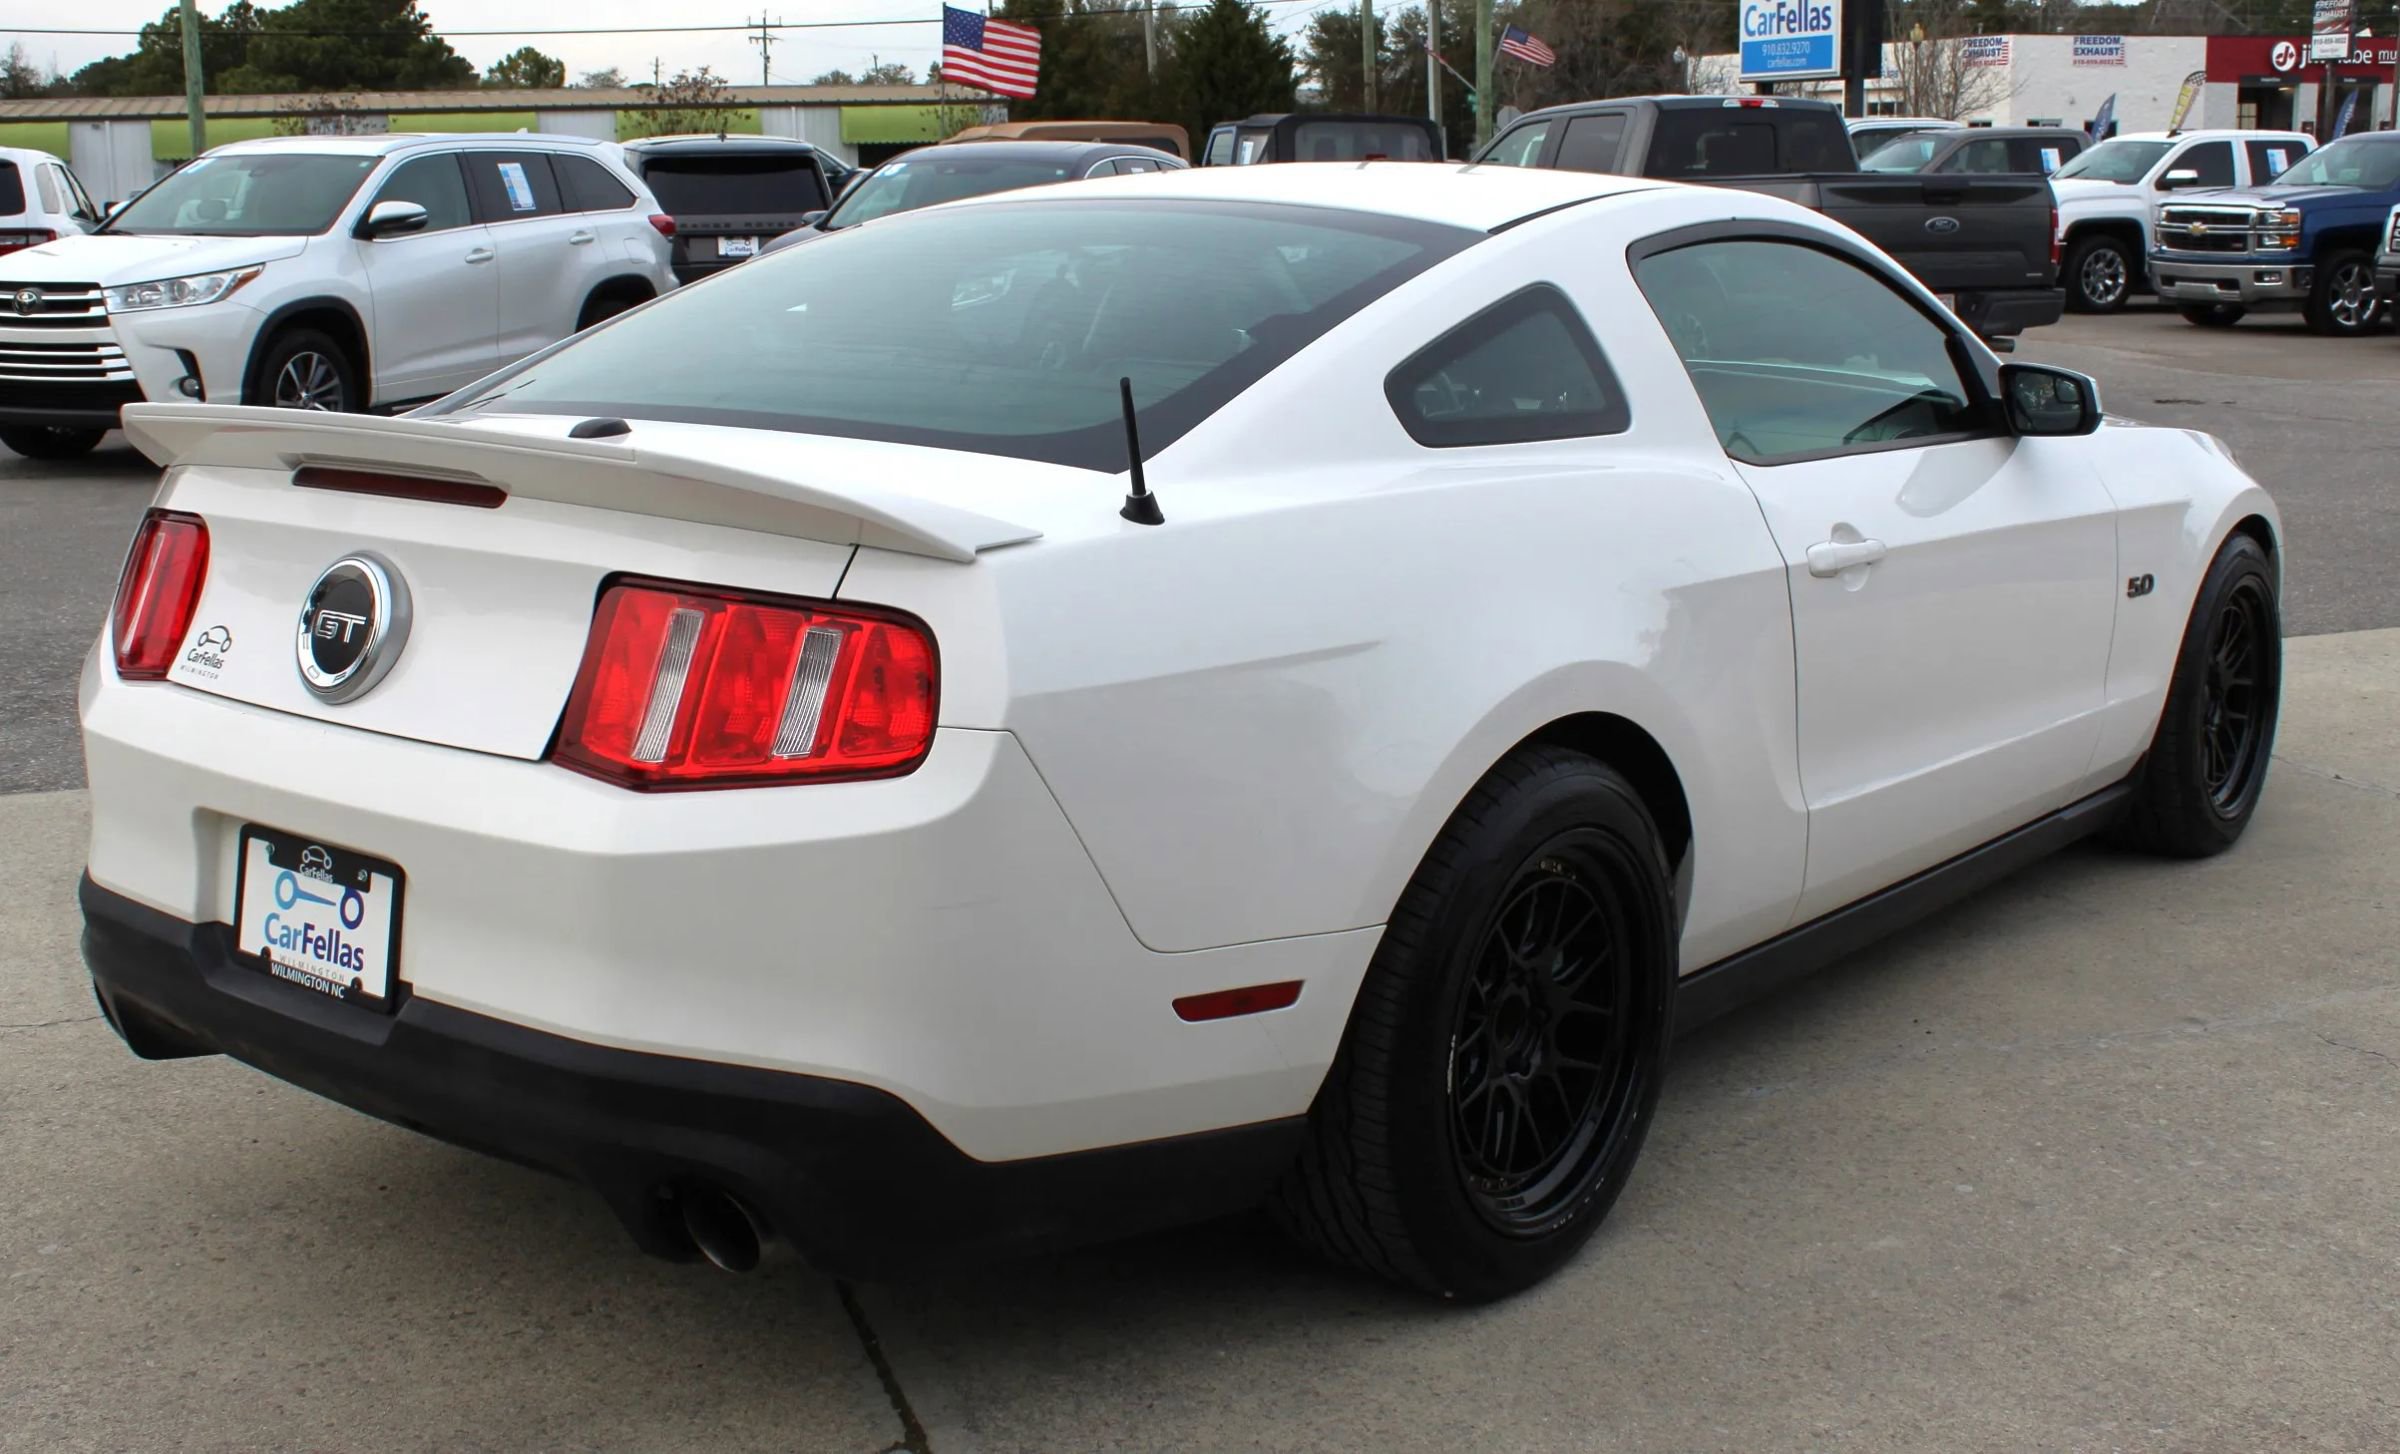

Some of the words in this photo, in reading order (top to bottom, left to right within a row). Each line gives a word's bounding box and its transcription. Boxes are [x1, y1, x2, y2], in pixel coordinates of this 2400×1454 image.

[1744, 0, 1832, 37] CarFellas
[2073, 36, 2120, 45] FREEDOM
[2073, 47, 2120, 56] EXHAUST
[315, 609, 367, 644] GT
[187, 647, 224, 669] CarFellas
[299, 863, 335, 884] CarFellas
[264, 911, 365, 972] CarFellas
[271, 962, 330, 992] WILMINGTON
[331, 982, 345, 999] NC
[279, 953, 345, 983] WILMINGTON
